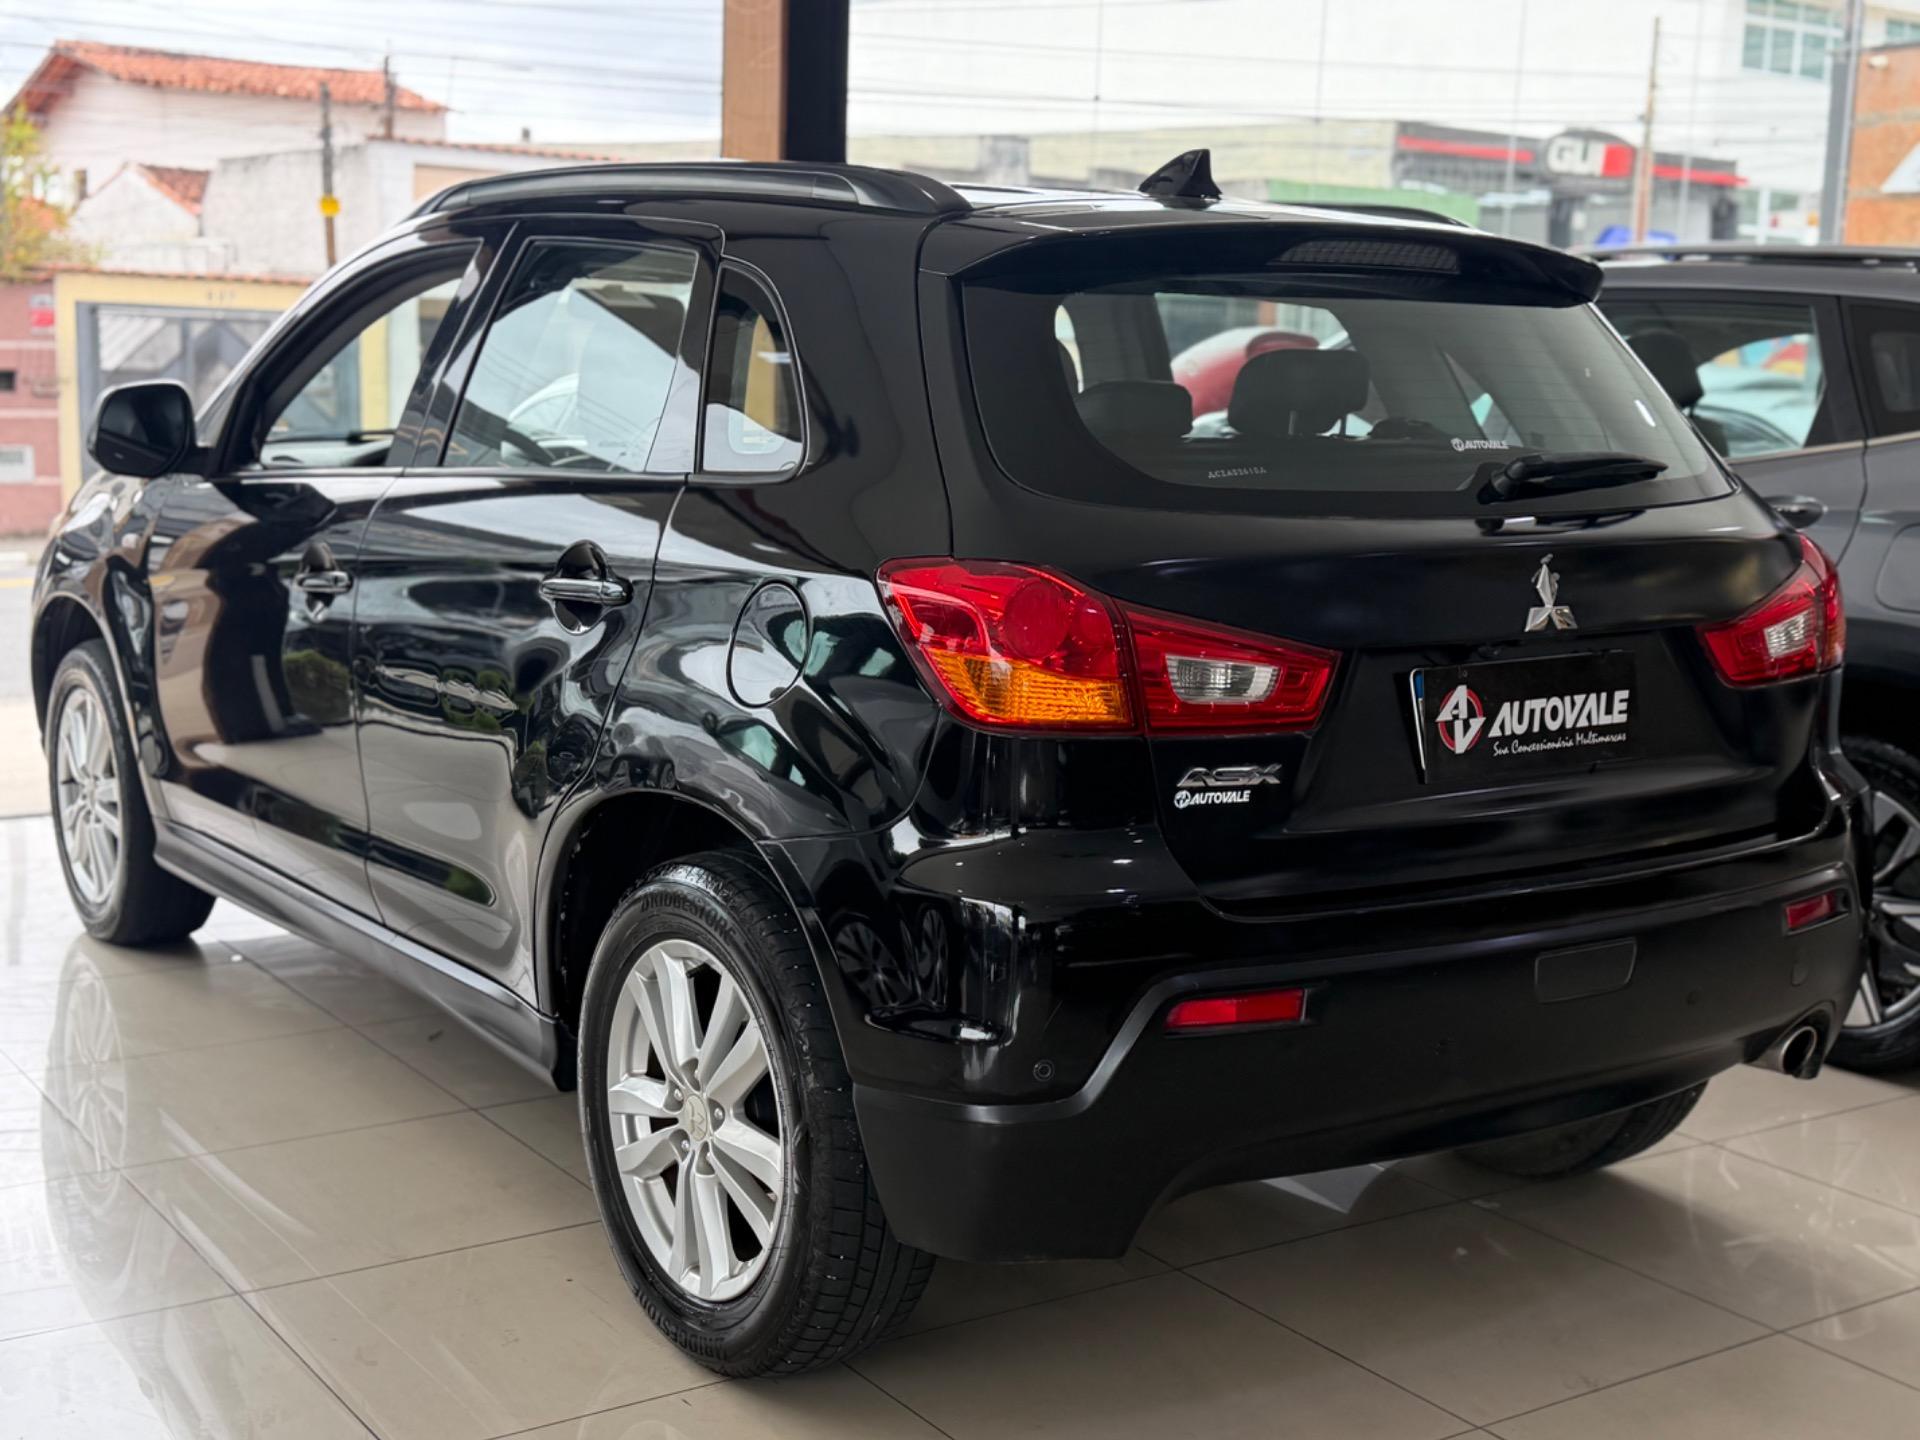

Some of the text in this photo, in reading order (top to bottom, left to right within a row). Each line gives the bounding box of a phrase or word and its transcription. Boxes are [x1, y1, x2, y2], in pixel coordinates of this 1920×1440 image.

[1464, 439, 1509, 450] AUTOVALE
[1487, 689, 1630, 739] AUTOVALE
[1493, 740, 1510, 757] Sua
[1576, 730, 1627, 746] Multimarcas
[1176, 762, 1282, 788] ASX
[1189, 790, 1252, 806] AUTOVALE
